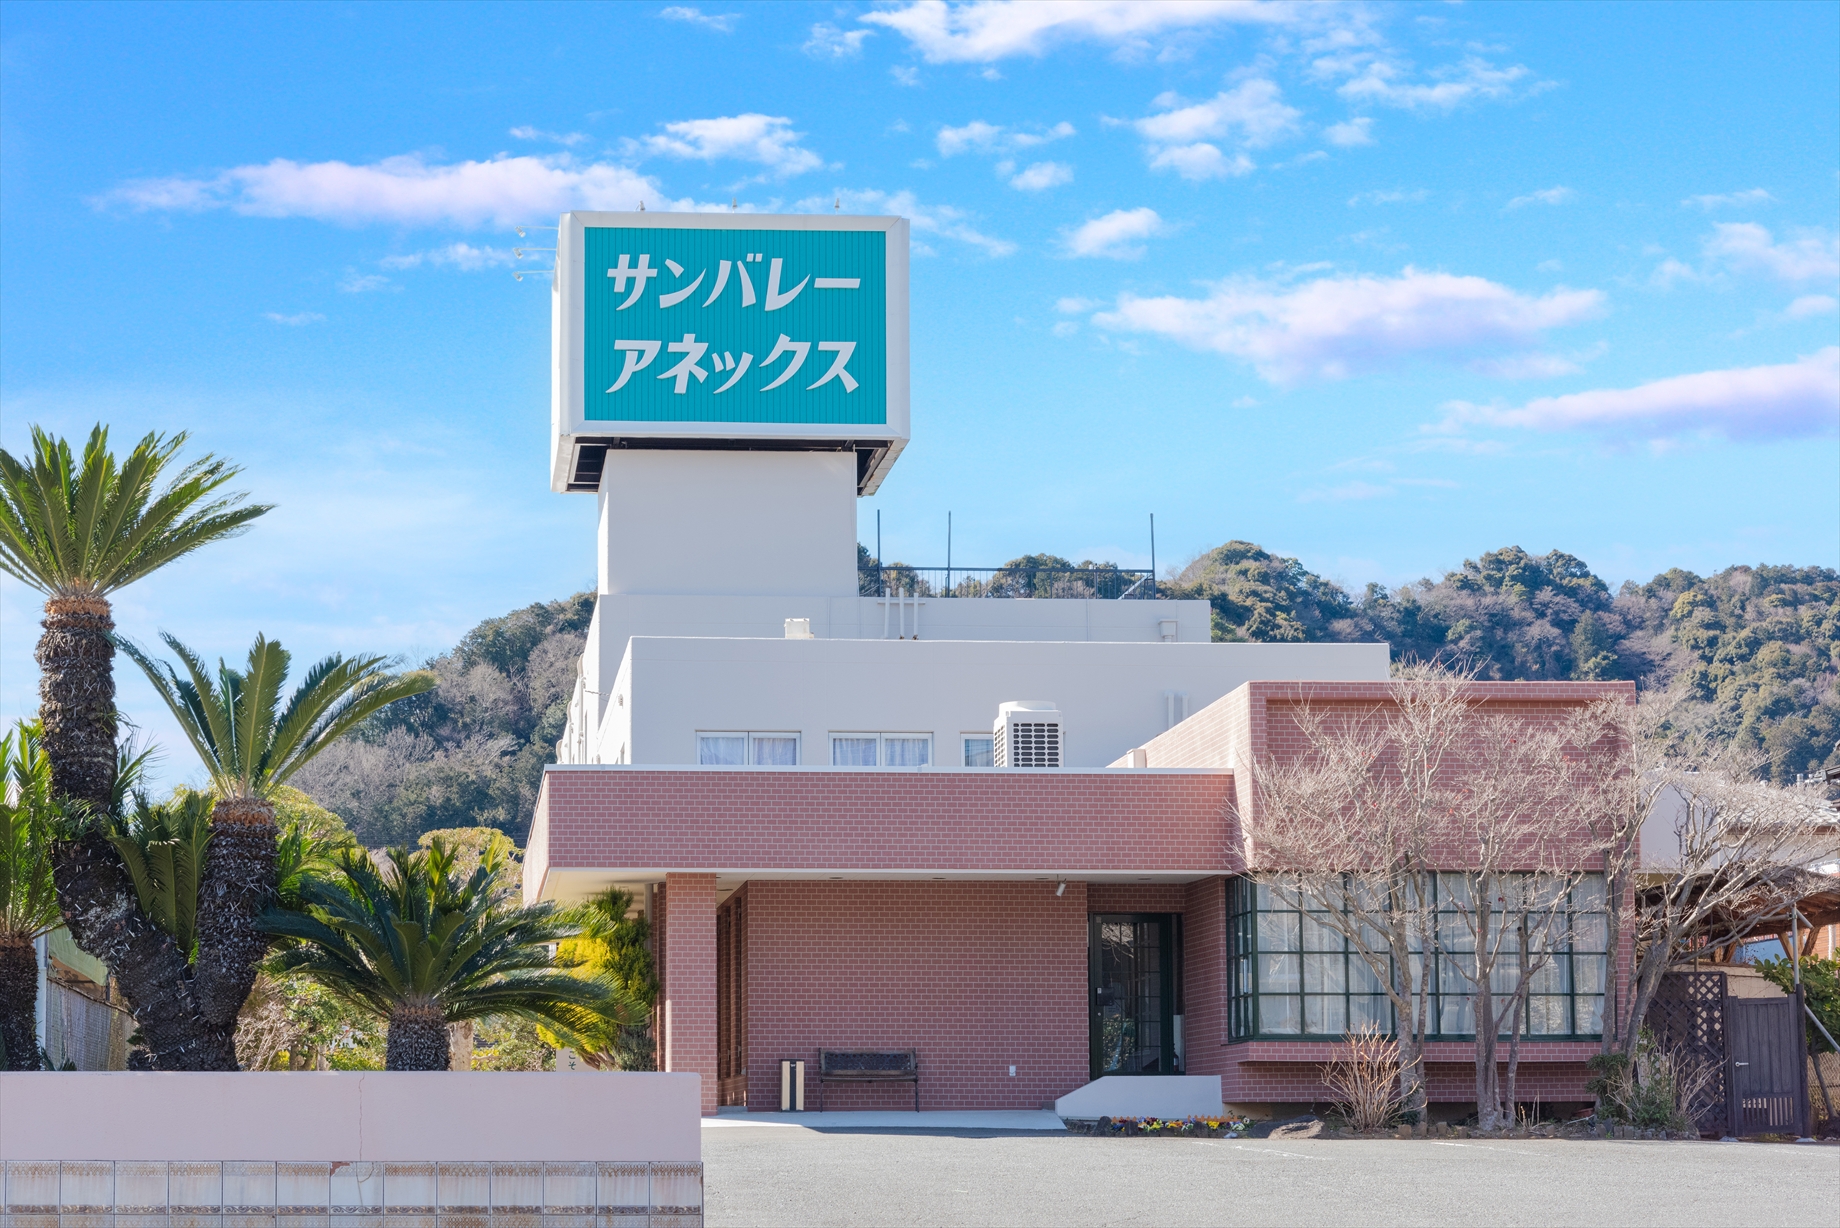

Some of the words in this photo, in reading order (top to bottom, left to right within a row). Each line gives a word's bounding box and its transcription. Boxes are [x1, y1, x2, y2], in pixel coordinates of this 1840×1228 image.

[607, 253, 861, 311] サンバレー
[606, 333, 860, 394] アネックス
